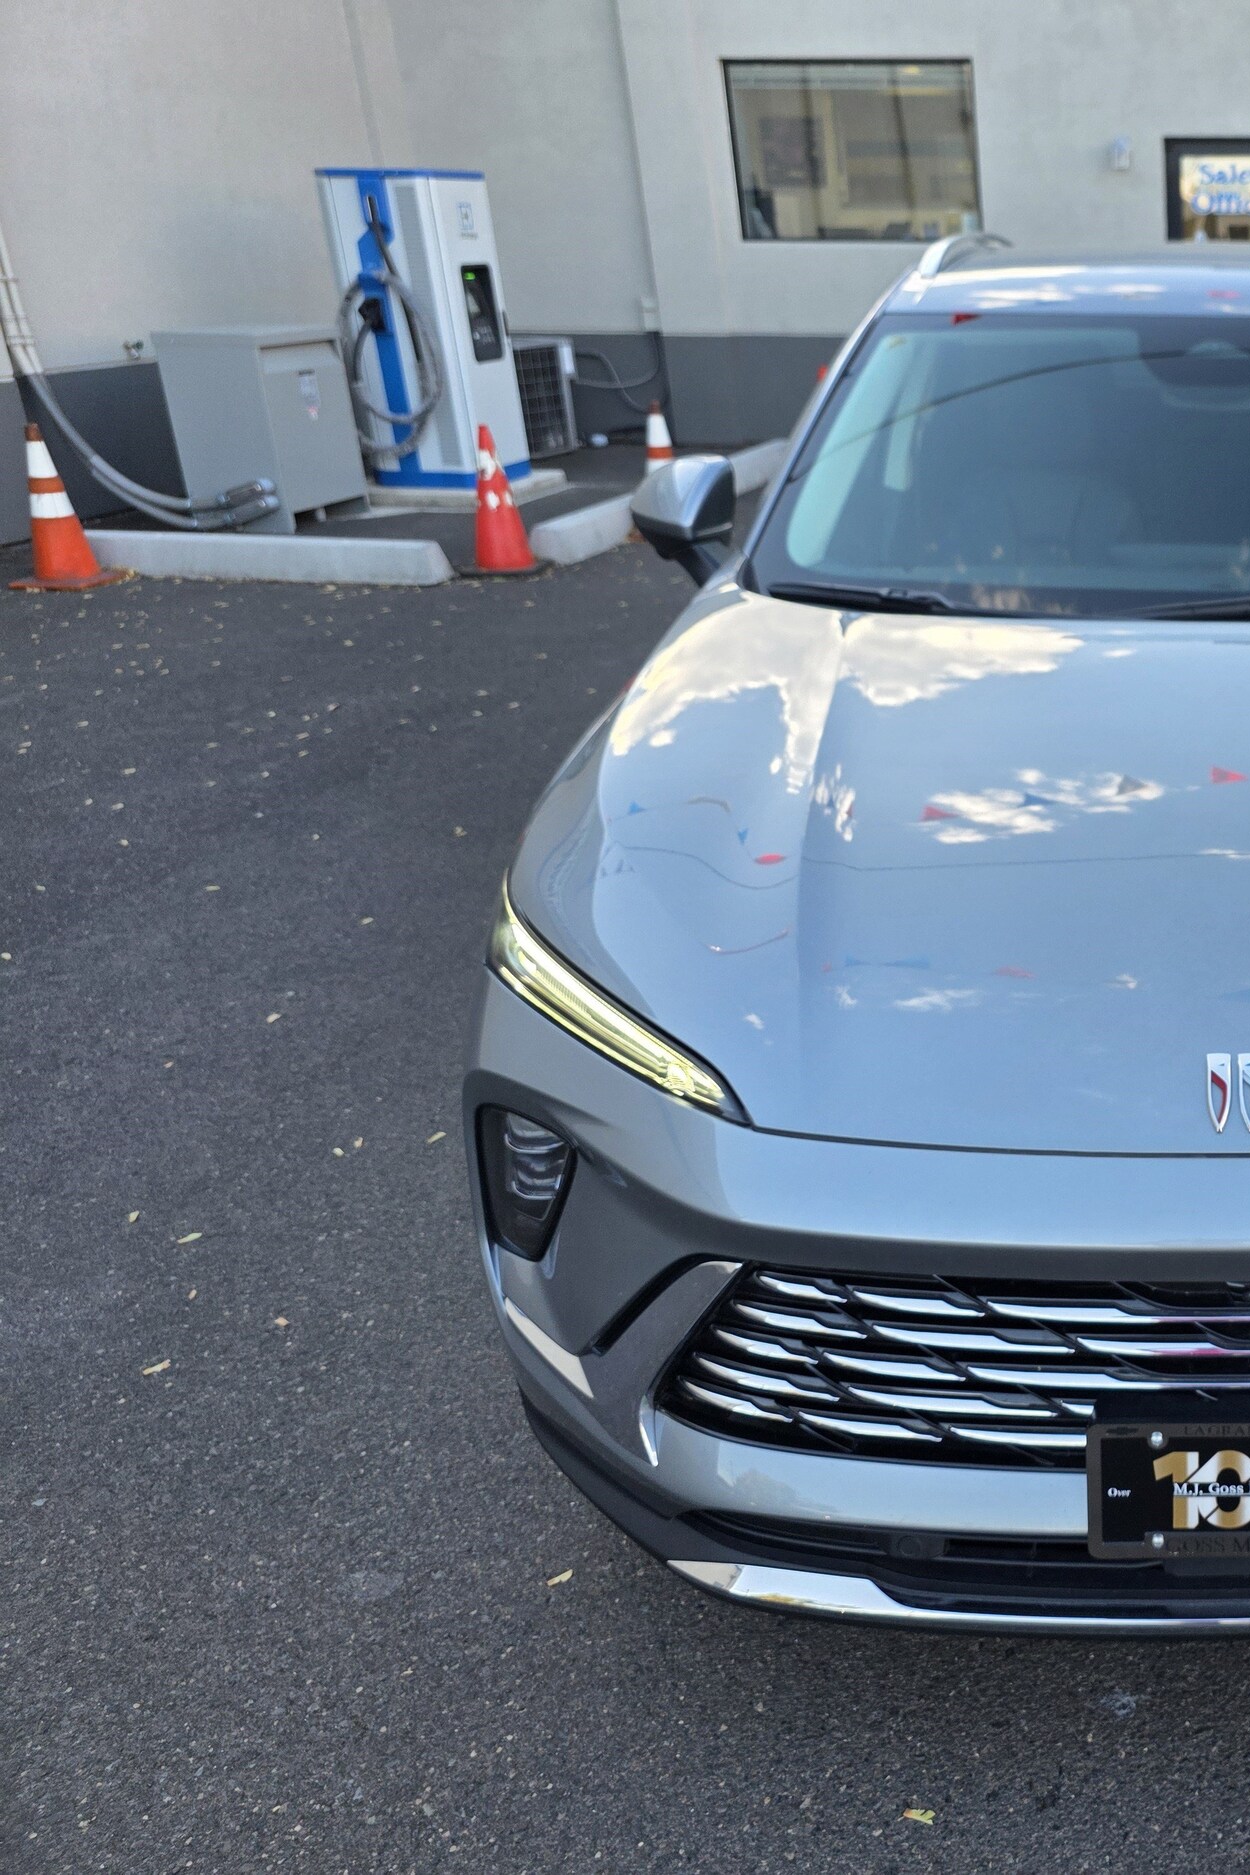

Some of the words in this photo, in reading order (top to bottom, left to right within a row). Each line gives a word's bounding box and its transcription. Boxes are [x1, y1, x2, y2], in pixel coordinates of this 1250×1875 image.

[1107, 1487, 1131, 1498] Over
[1173, 1482, 1203, 1495] M.J.
[1208, 1482, 1244, 1495] Goss
[1166, 1535, 1226, 1552] GOSS
